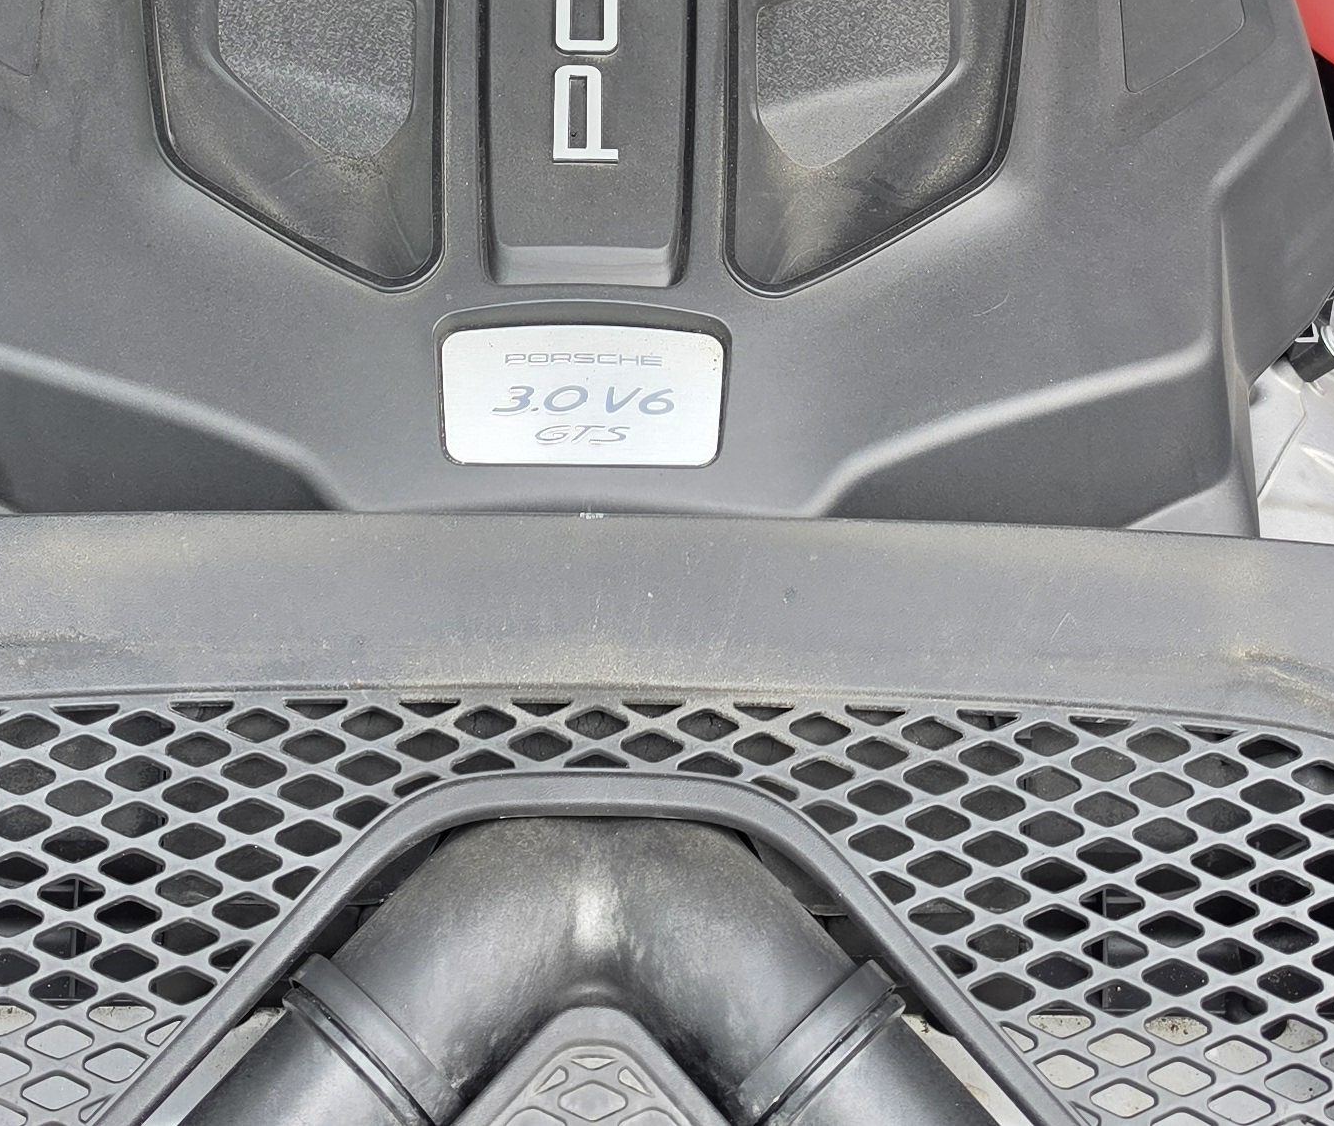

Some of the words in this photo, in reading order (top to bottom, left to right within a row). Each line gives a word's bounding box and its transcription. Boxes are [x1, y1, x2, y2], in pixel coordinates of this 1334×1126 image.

[504, 352, 663, 367] PORSCHE
[492, 385, 589, 415] 3.0
[604, 385, 675, 415] V6
[534, 424, 631, 445] GTS
